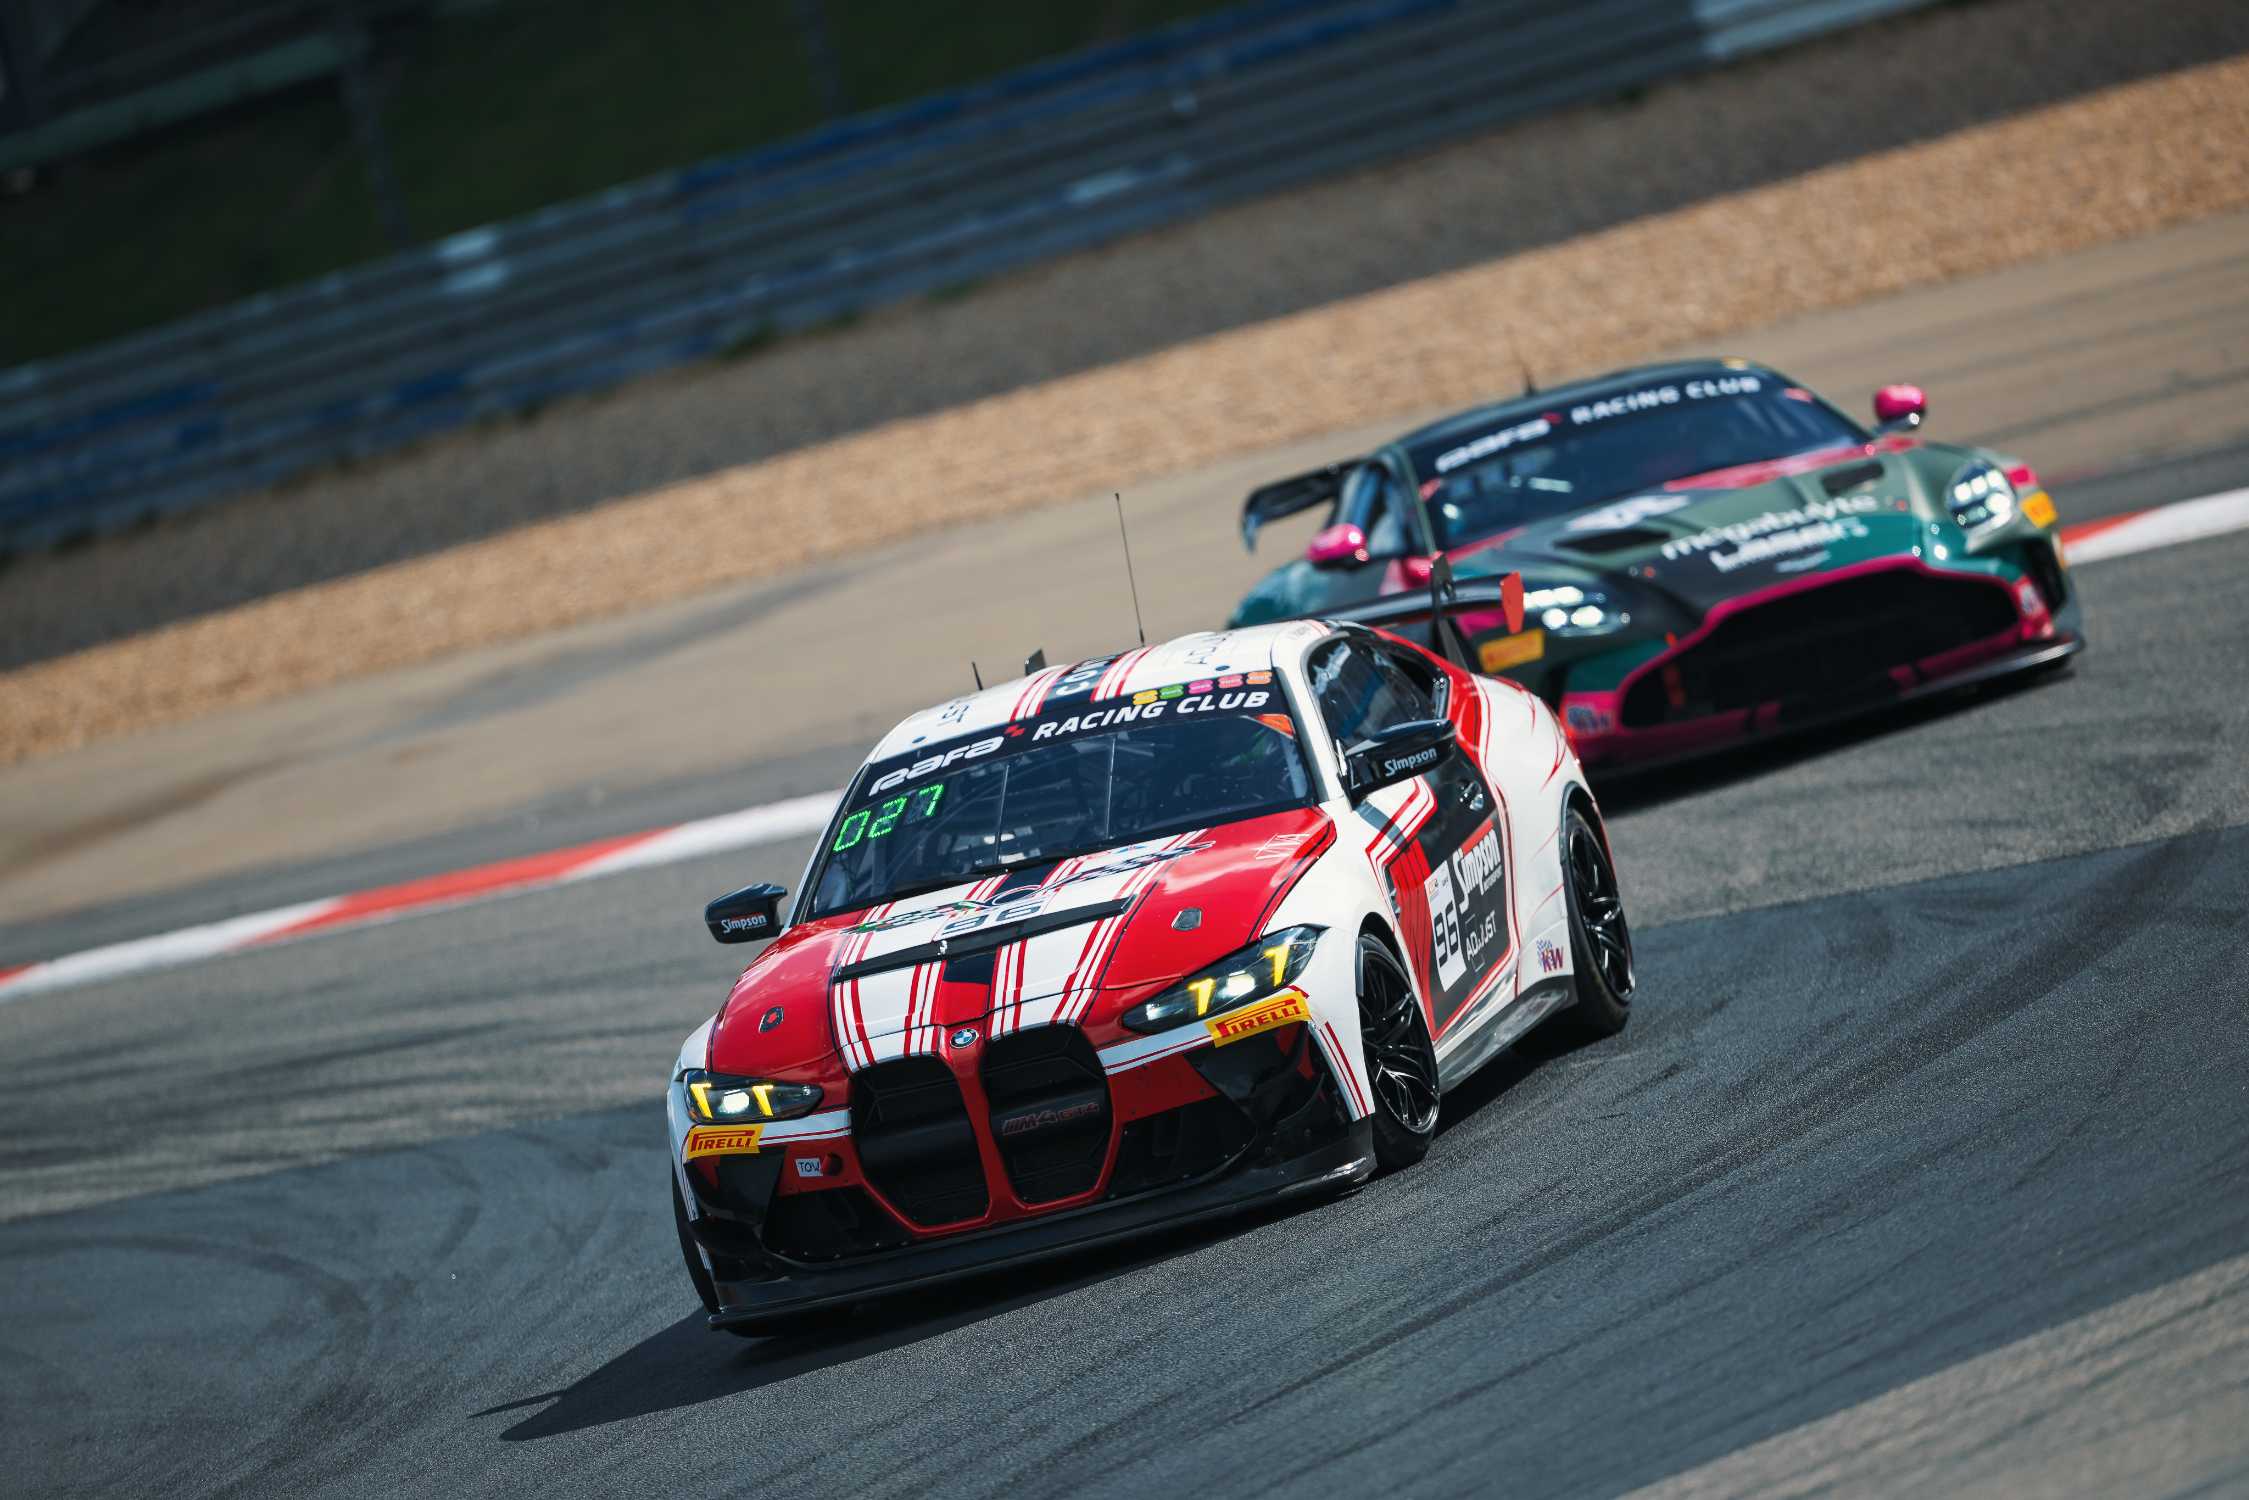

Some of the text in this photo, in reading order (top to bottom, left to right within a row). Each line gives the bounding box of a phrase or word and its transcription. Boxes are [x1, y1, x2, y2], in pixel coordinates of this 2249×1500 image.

[1571, 385, 1680, 425] RACING
[1685, 376, 1761, 400] CLUB
[1031, 699, 1168, 742] RACING
[1176, 691, 1270, 715] CLUB
[1383, 746, 1438, 778] Simpson
[832, 783, 945, 852] 027
[1452, 828, 1502, 914] Simpson
[720, 913, 768, 935] Simpson
[1465, 909, 1498, 962] ADJUST
[1215, 997, 1304, 1038] PIRELLI
[689, 1129, 756, 1153] PIRELLI
